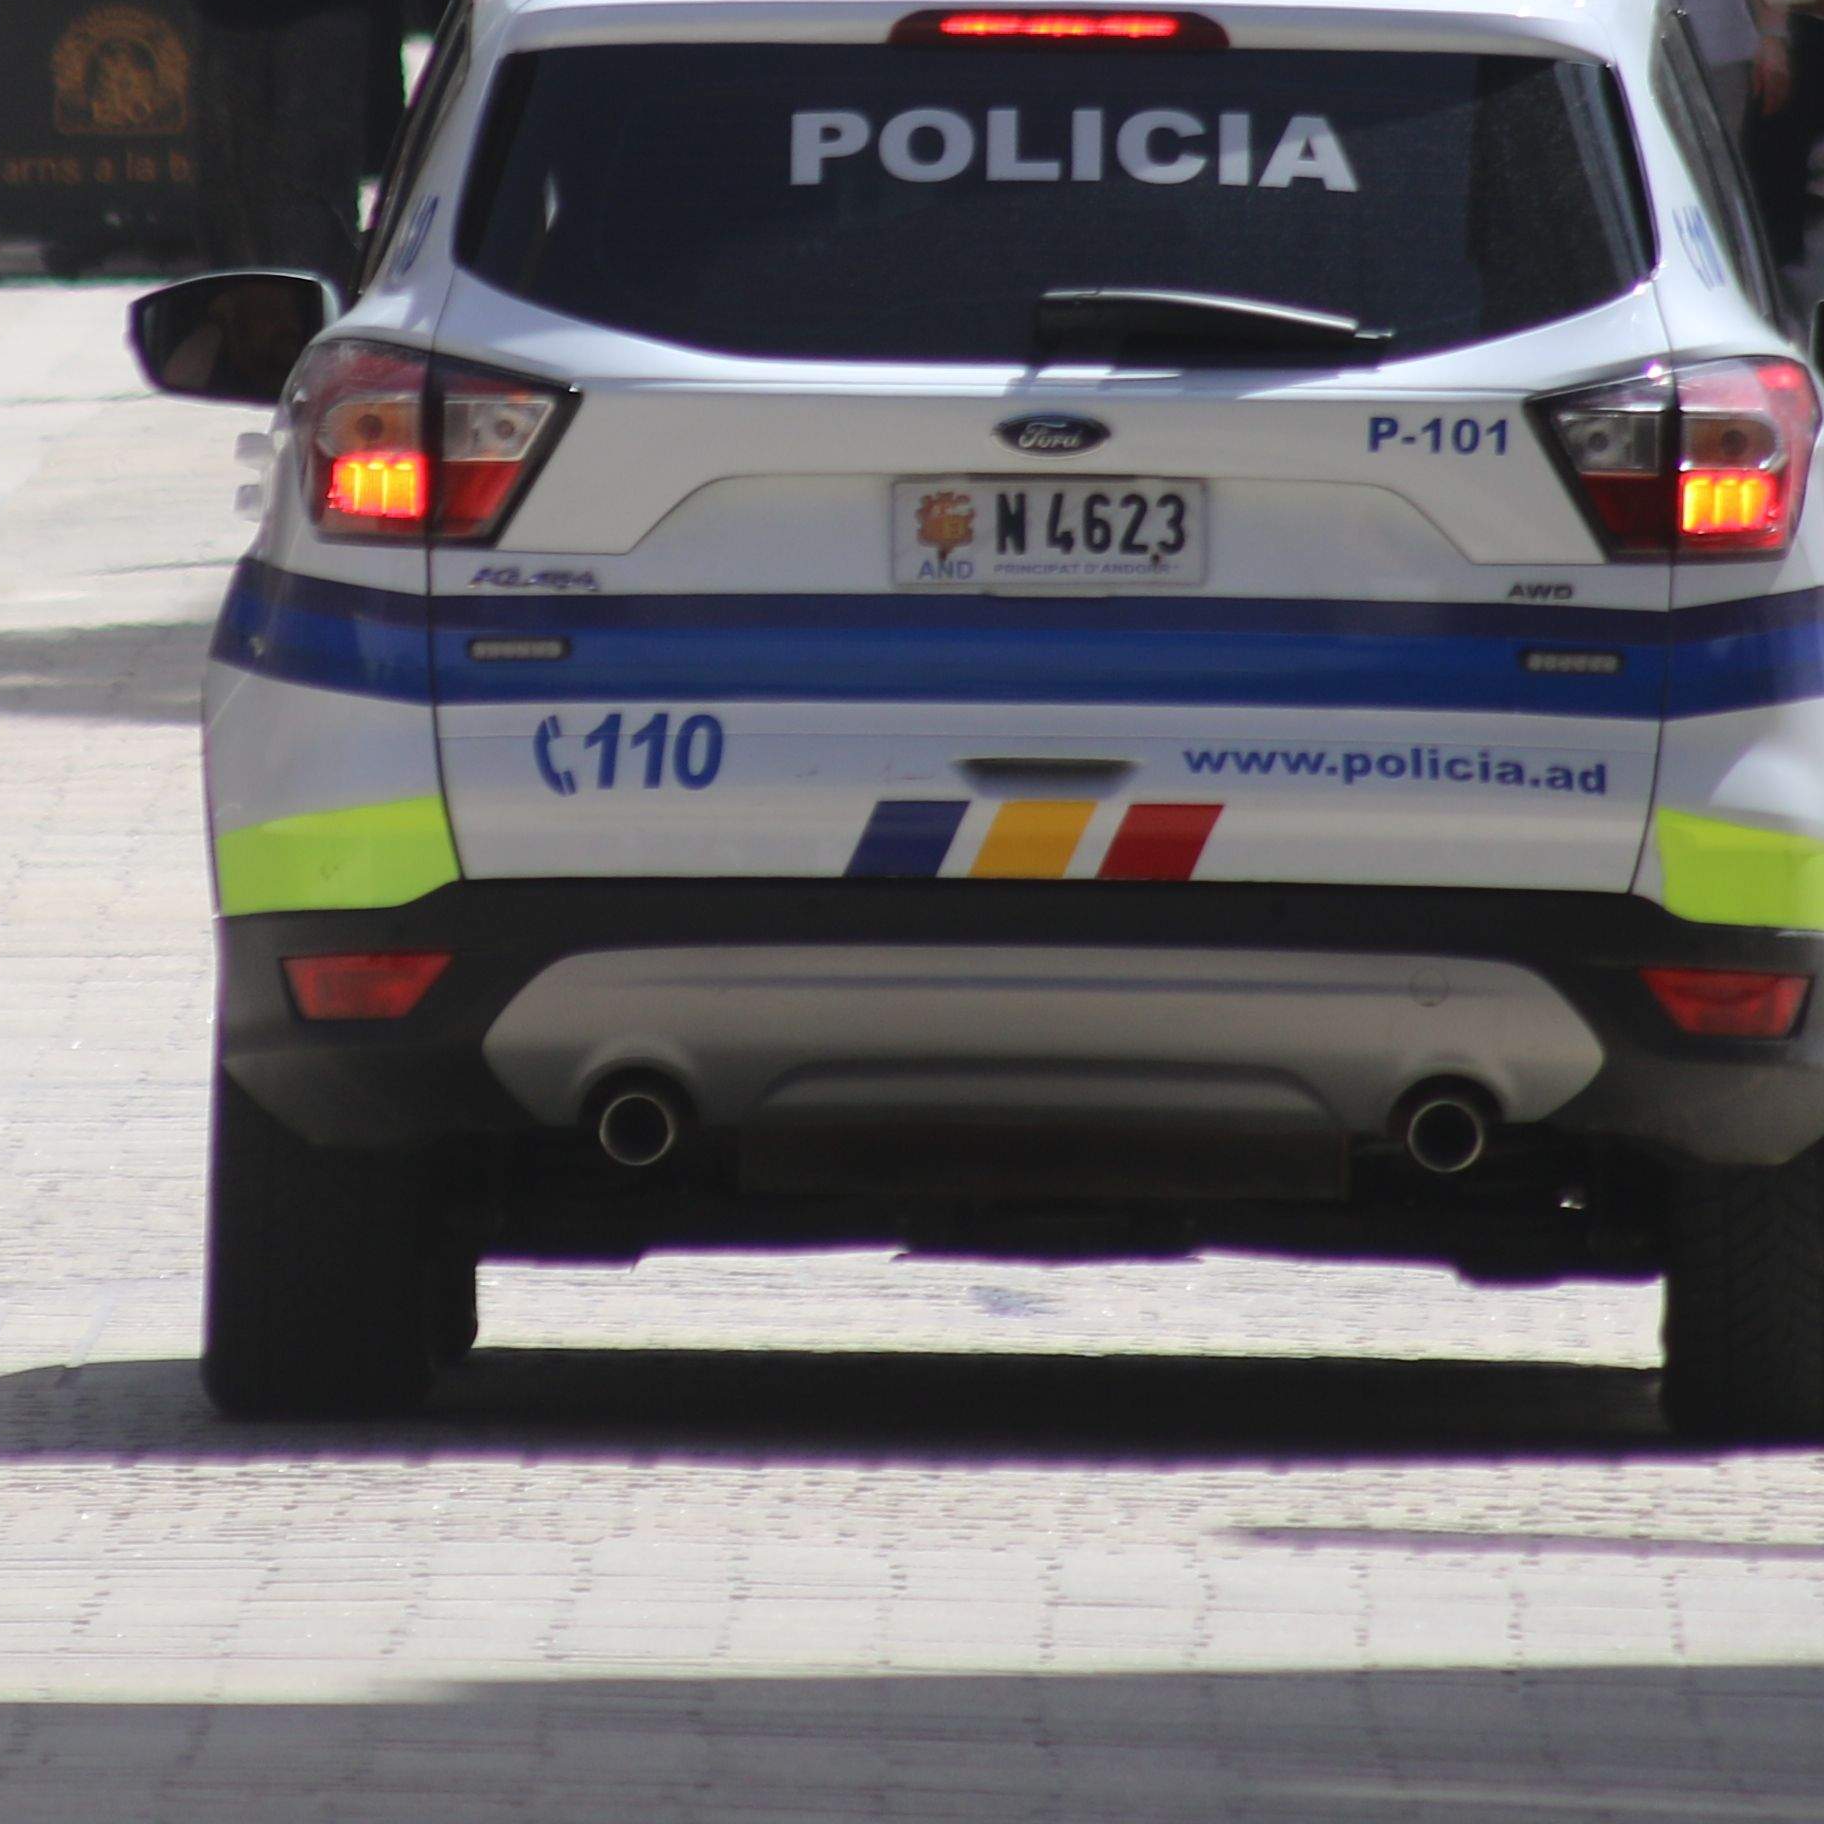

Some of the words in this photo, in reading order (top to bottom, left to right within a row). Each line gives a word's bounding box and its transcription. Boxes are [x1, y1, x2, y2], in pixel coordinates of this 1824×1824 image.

[789, 108, 1361, 193] POLICIA
[1018, 422, 1081, 449] Ford
[1368, 416, 1508, 456] P-101
[996, 492, 1026, 556] N
[1046, 491, 1186, 555] 4623
[917, 560, 974, 580] AND
[993, 563, 1079, 576] PRINCIPAT
[1507, 583, 1573, 599] AWD
[583, 712, 724, 791] 110
[1182, 747, 1608, 795] www.policia.ad
